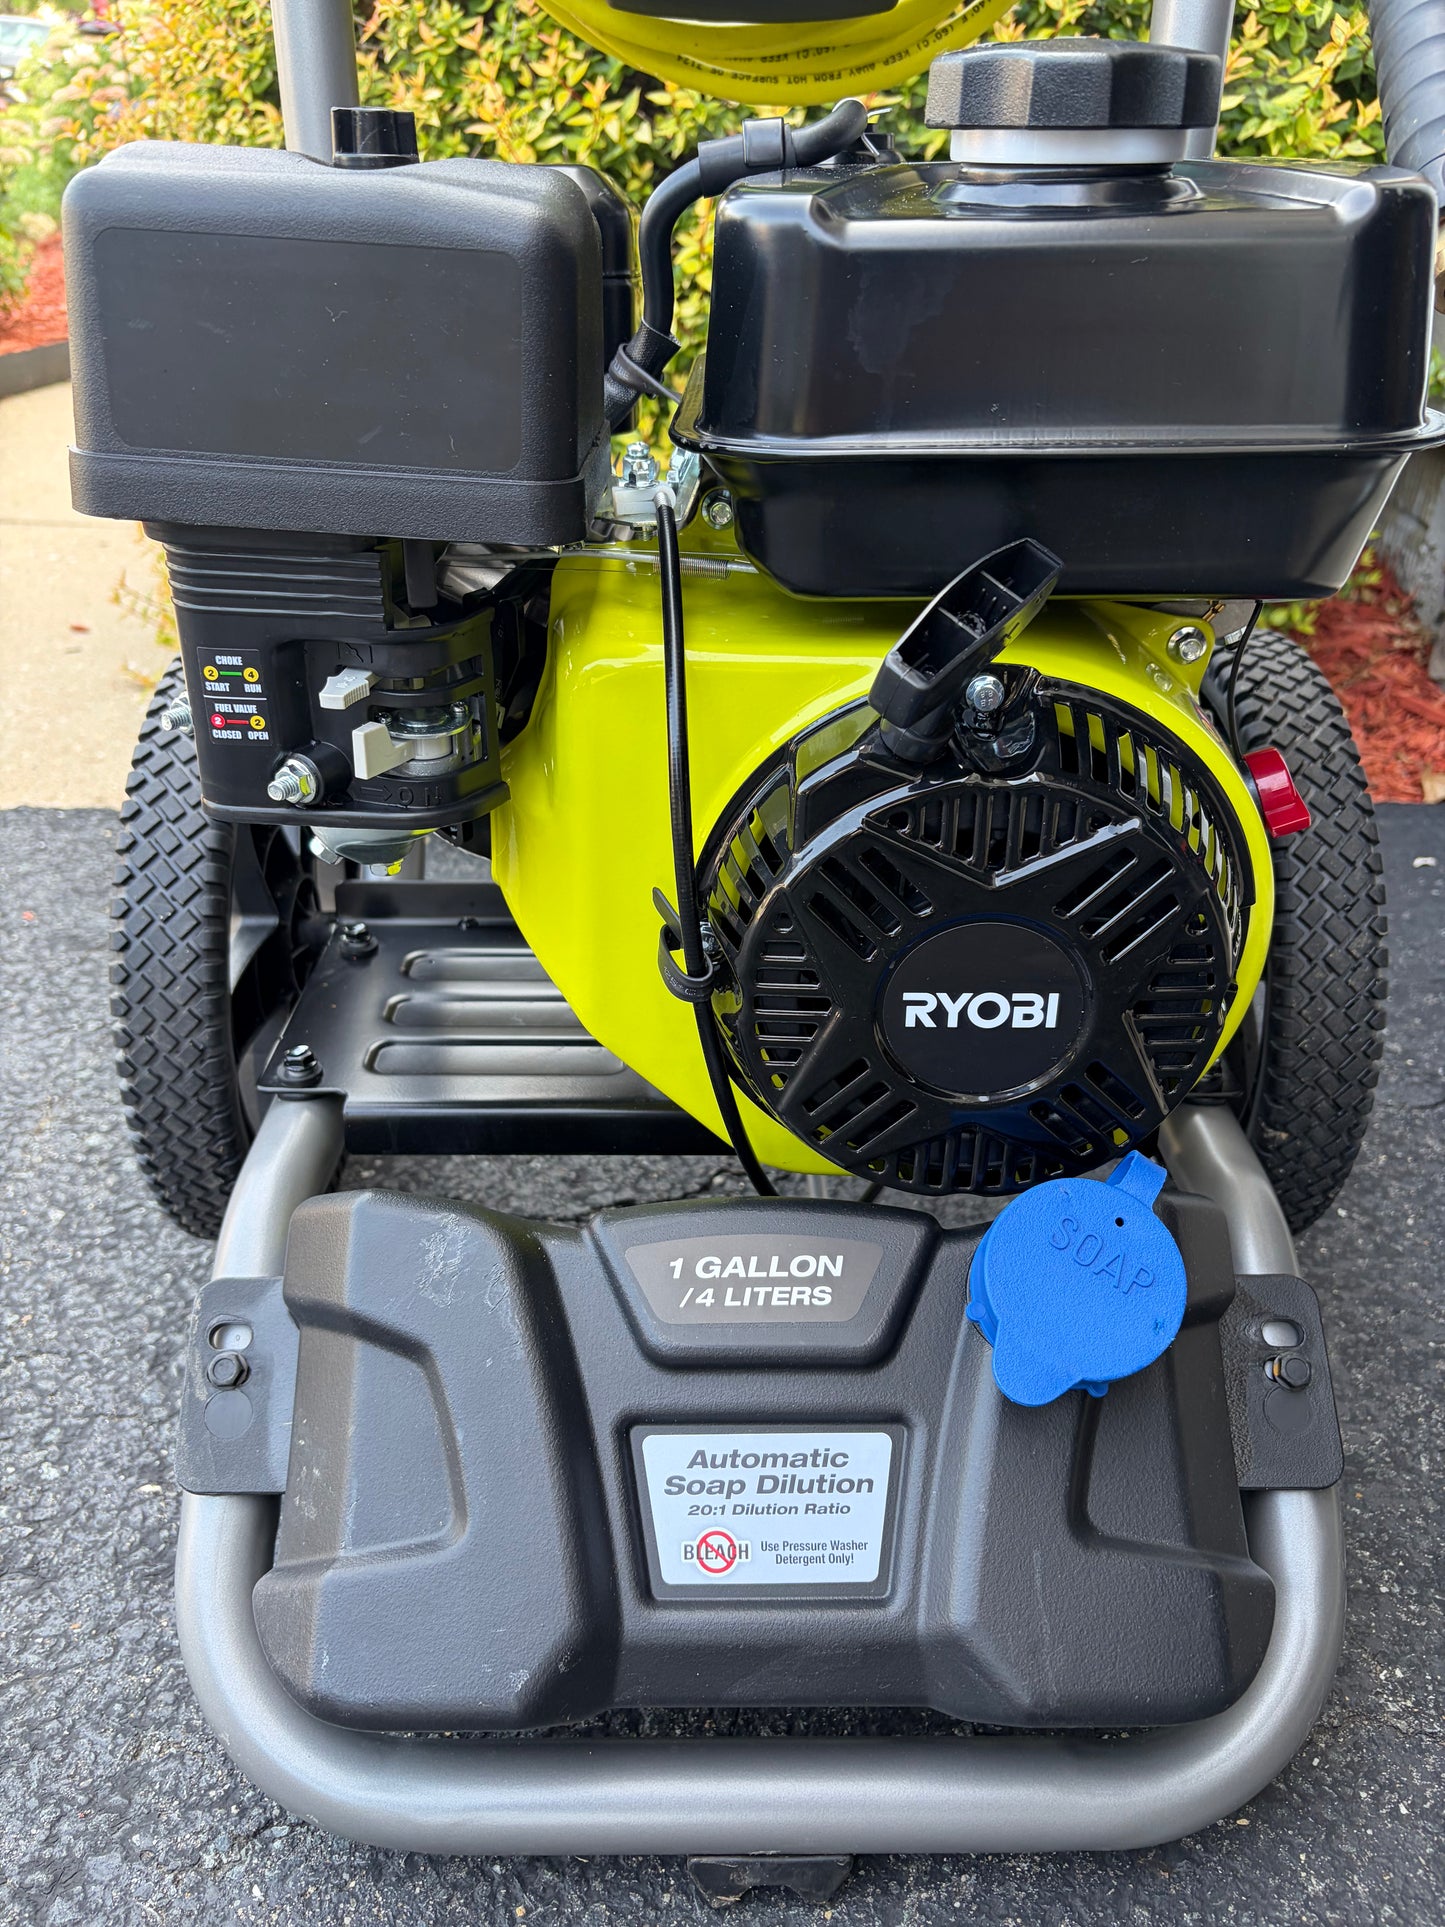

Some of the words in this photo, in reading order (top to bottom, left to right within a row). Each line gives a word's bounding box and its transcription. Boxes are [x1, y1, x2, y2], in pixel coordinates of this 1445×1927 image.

[883, 48, 910, 66] KEEP
[849, 62, 876, 77] AWAY
[731, 71, 779, 85] SURFACE
[787, 76, 807, 84] HOT
[814, 71, 842, 83] FROM
[215, 656, 243, 665] CHOKE
[207, 669, 215, 678] 2
[247, 671, 255, 679] 4
[205, 682, 230, 692] START
[244, 683, 262, 693] RUN
[214, 703, 233, 713] FUEL
[233, 704, 258, 714] VALVE
[214, 716, 222, 725] 2
[254, 718, 262, 727] 2
[212, 729, 242, 740] CLOSED
[247, 731, 269, 740] OPEN
[902, 992, 1060, 1029] RYOBI
[1050, 1217, 1155, 1295] SOAP
[669, 1257, 684, 1279] 1
[695, 1255, 844, 1279] GALLON
[724, 1286, 832, 1307] LITERS
[687, 1448, 849, 1469] Automatic
[664, 1475, 746, 1499] Soap
[756, 1474, 874, 1495] Dilution
[687, 1504, 726, 1516] 20:1
[732, 1503, 799, 1516] Dilution
[804, 1503, 851, 1515] Ratio
[684, 1543, 749, 1560] BLEACH
[760, 1541, 780, 1552] Use
[782, 1540, 828, 1552] Pressure
[830, 1540, 868, 1551] Washer
[775, 1554, 826, 1567] Detergent
[828, 1553, 854, 1567] Only!
